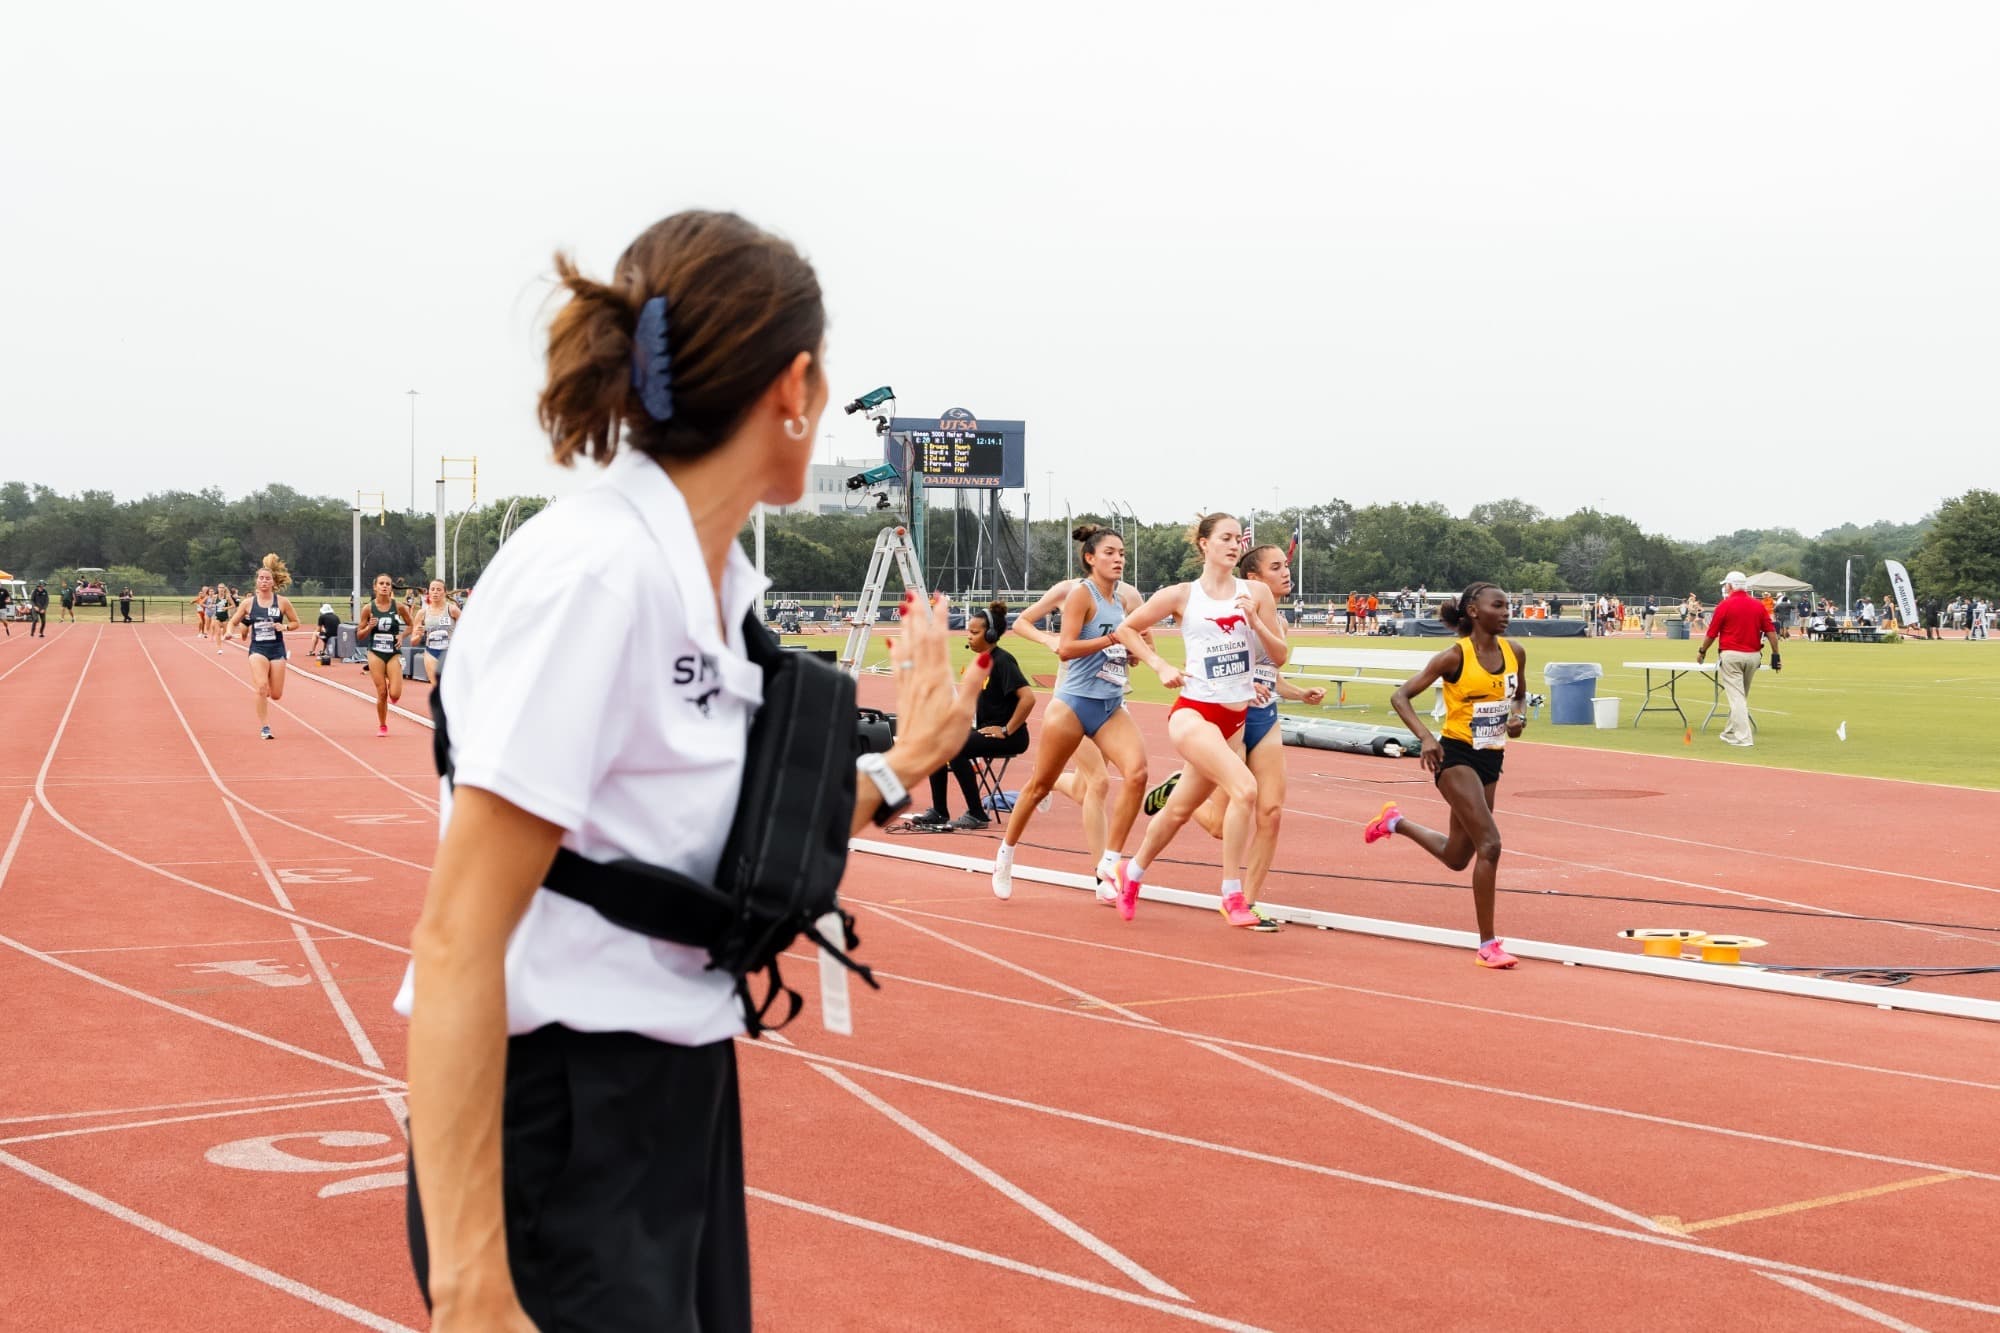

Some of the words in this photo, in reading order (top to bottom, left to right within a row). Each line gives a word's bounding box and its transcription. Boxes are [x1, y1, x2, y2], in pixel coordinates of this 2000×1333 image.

[940, 420, 977, 430] UTSA
[976, 438, 1003, 446] 12:14.1
[923, 476, 1000, 485] OADRUNNERS
[1206, 640, 1246, 653] AMERICAN
[1212, 661, 1245, 677] GEARIN
